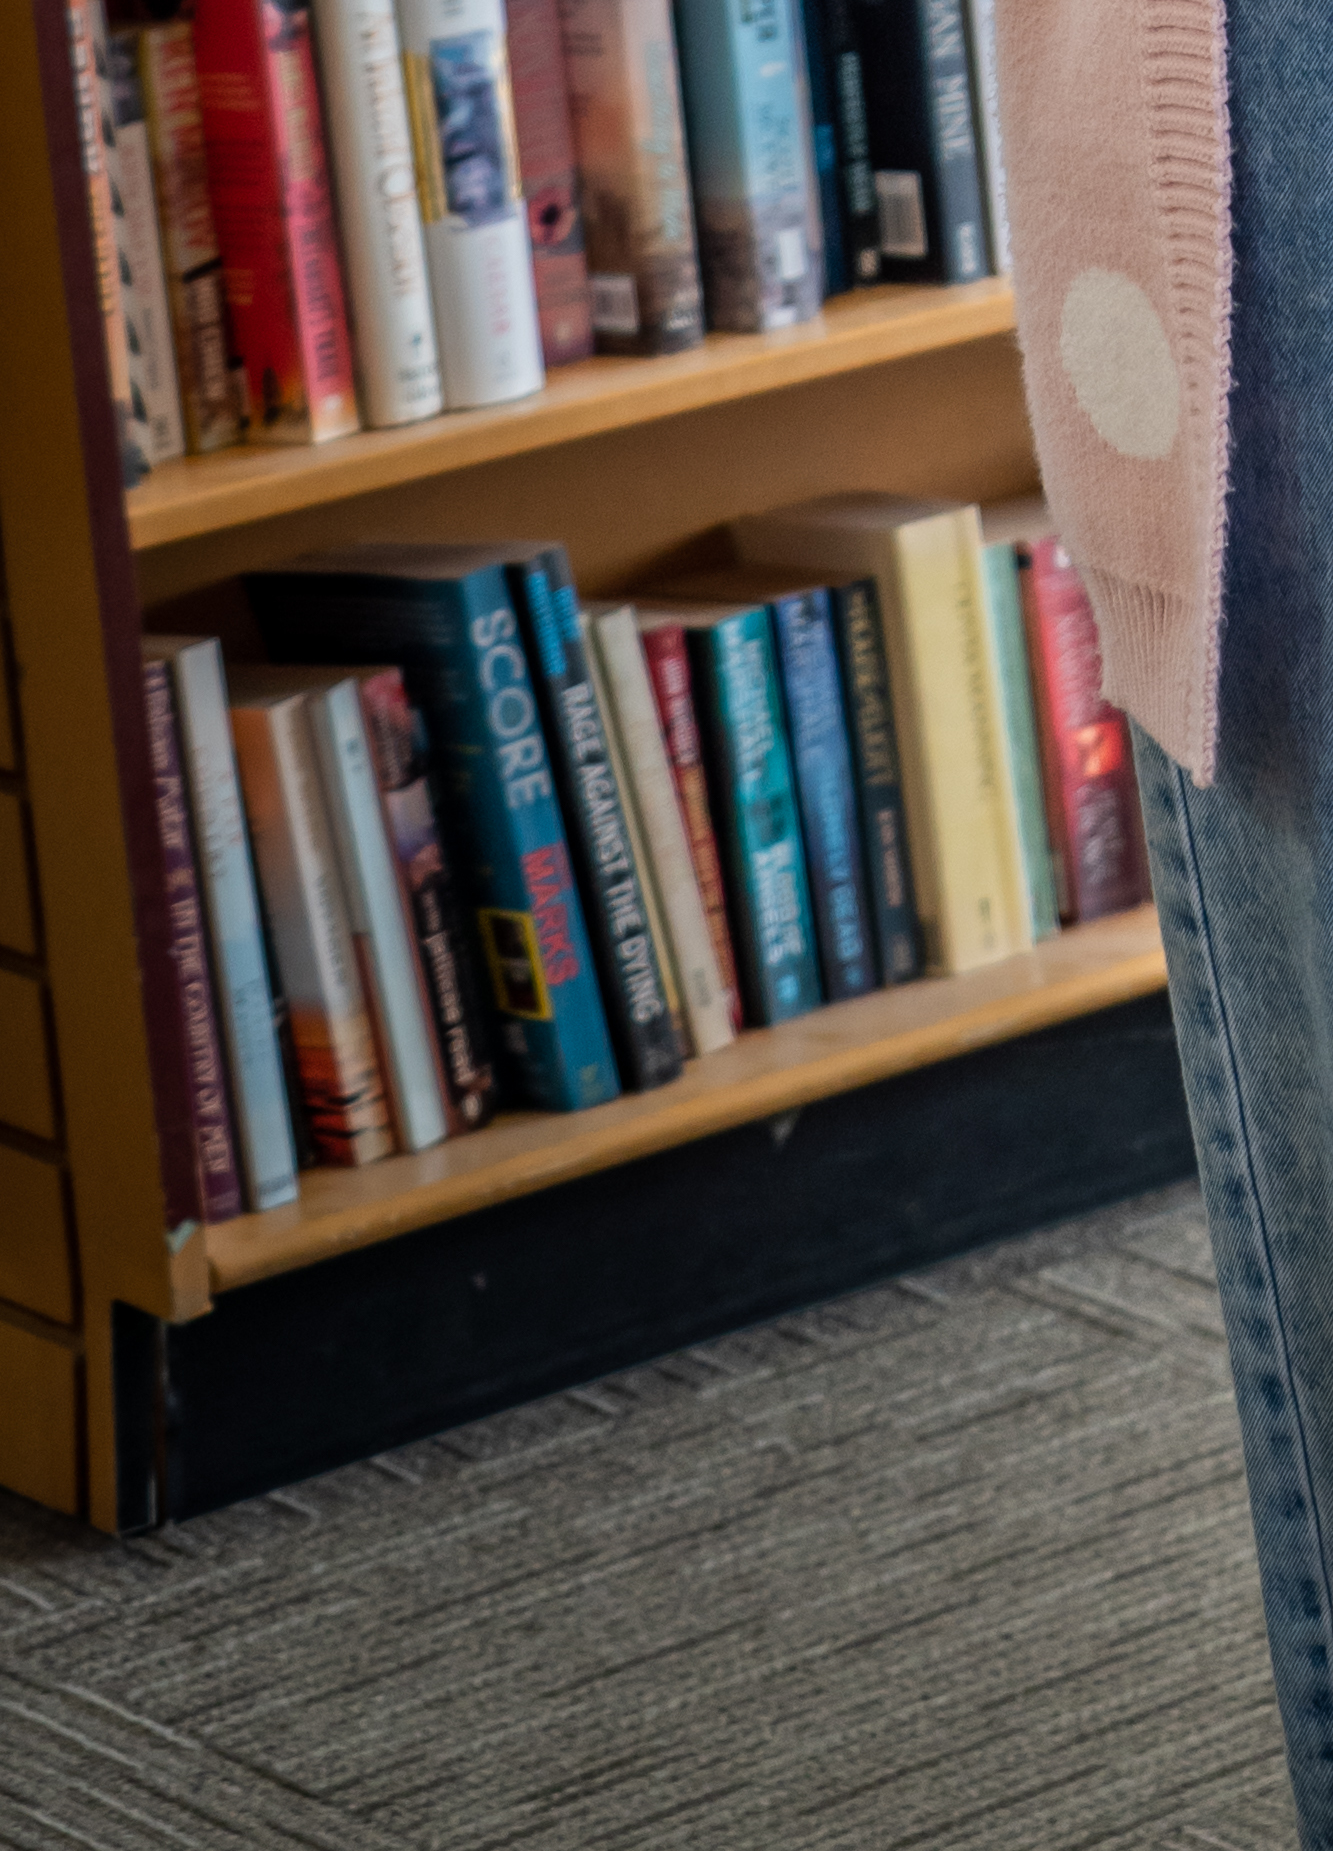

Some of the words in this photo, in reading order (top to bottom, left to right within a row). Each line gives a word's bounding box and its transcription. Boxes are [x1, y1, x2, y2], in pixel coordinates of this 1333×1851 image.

[934, 73, 974, 162] MINE
[471, 605, 553, 810] SCORE
[560, 682, 603, 760] RAGE
[577, 761, 630, 877] AGAINST
[519, 846, 580, 988] MARKS
[606, 878, 644, 938] THE
[829, 885, 864, 960] DEAD
[175, 926, 206, 976] THE
[618, 935, 664, 1026] DYING
[181, 979, 219, 1082] COUNTRY
[441, 1025, 480, 1087] road
[199, 1125, 231, 1175] MEN
